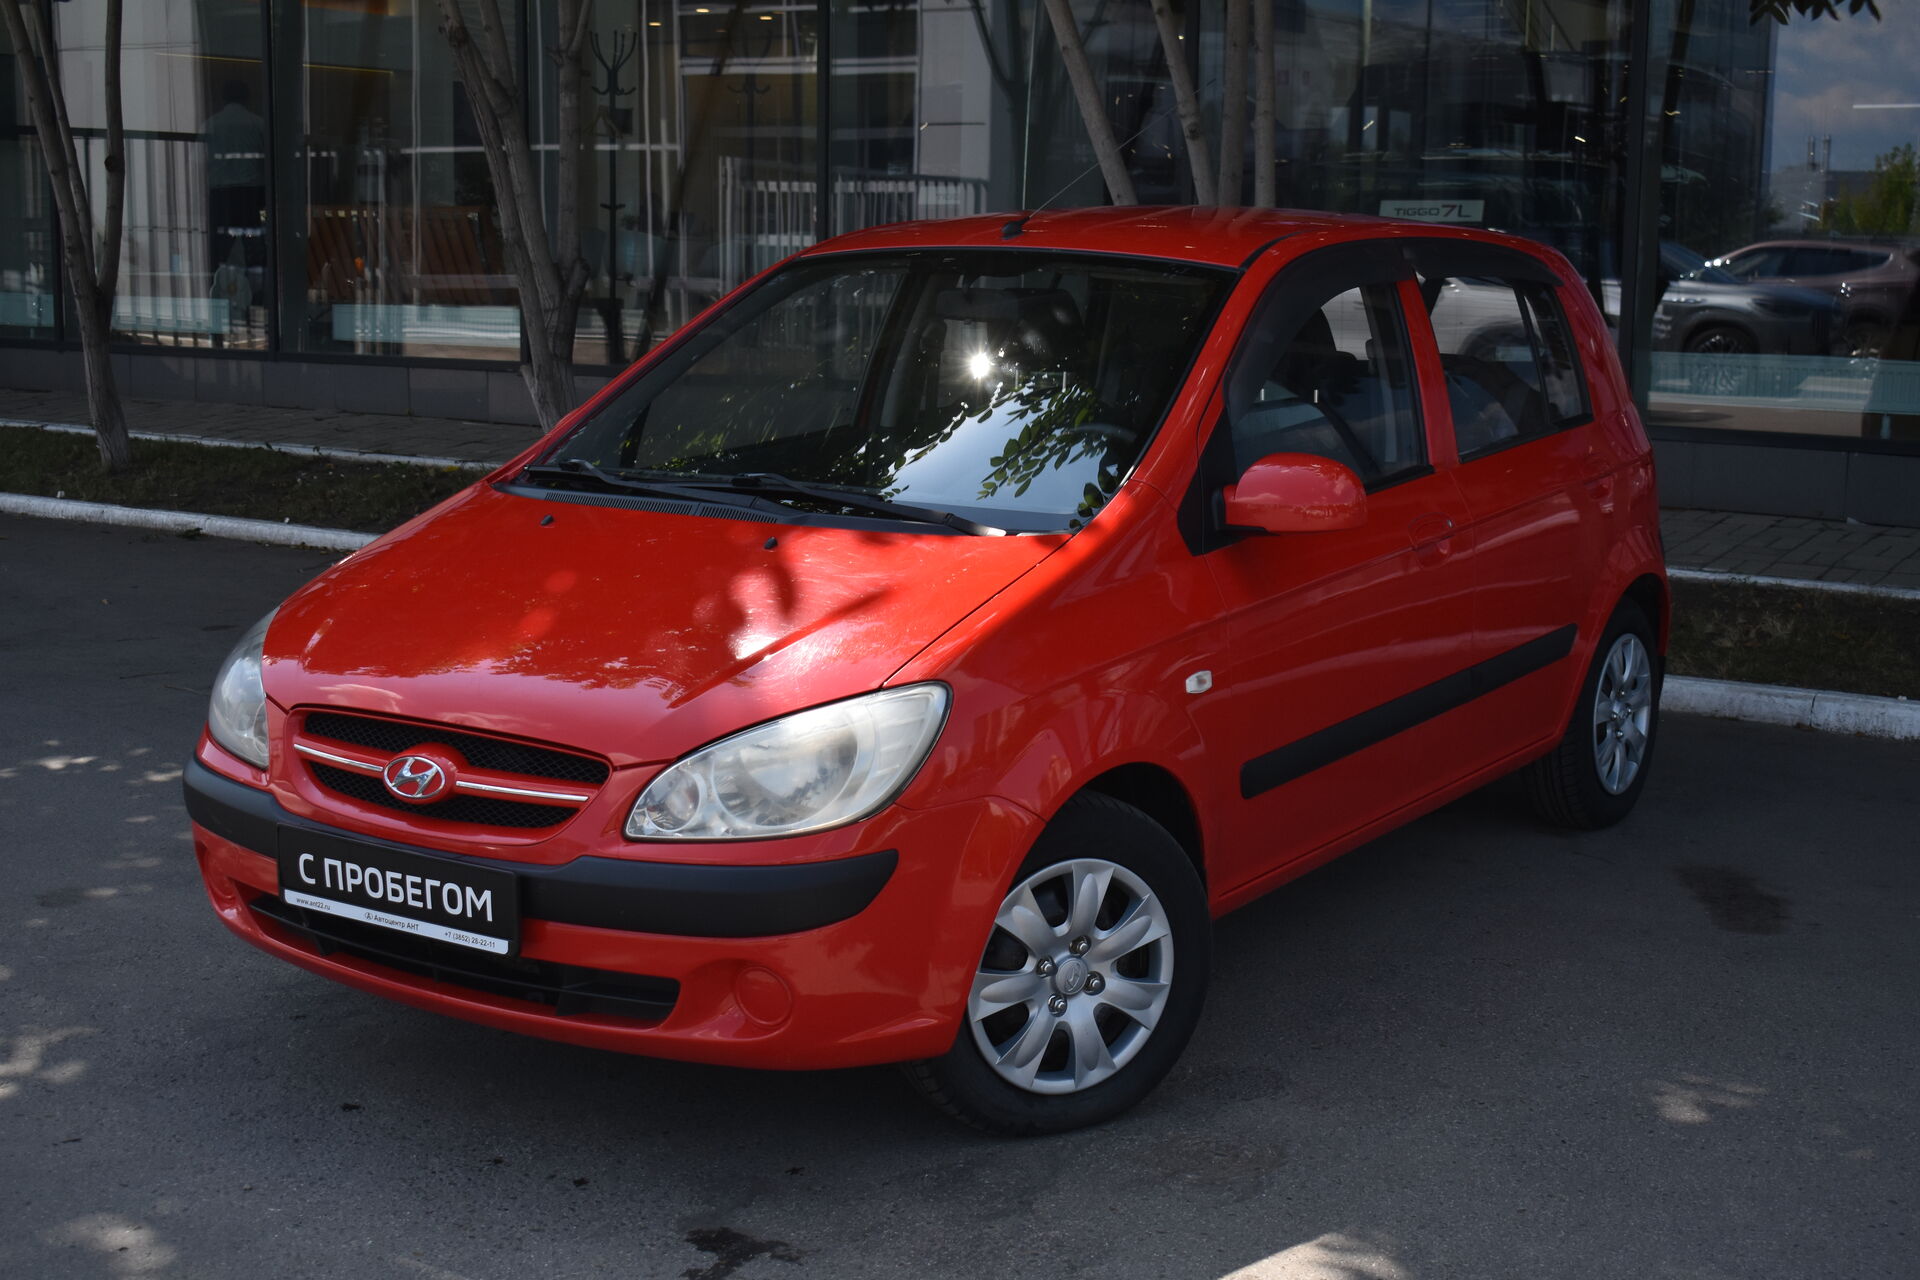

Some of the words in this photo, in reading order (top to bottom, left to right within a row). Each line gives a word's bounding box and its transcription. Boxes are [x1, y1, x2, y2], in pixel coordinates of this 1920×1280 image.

[298, 853, 316, 884] С
[324, 857, 493, 921] ПРОБЕГОМ
[296, 898, 331, 911] www.ant22.ru
[374, 915, 406, 929] Автоцентр
[406, 922, 420, 931] АНТ
[445, 931, 452, 939] +7
